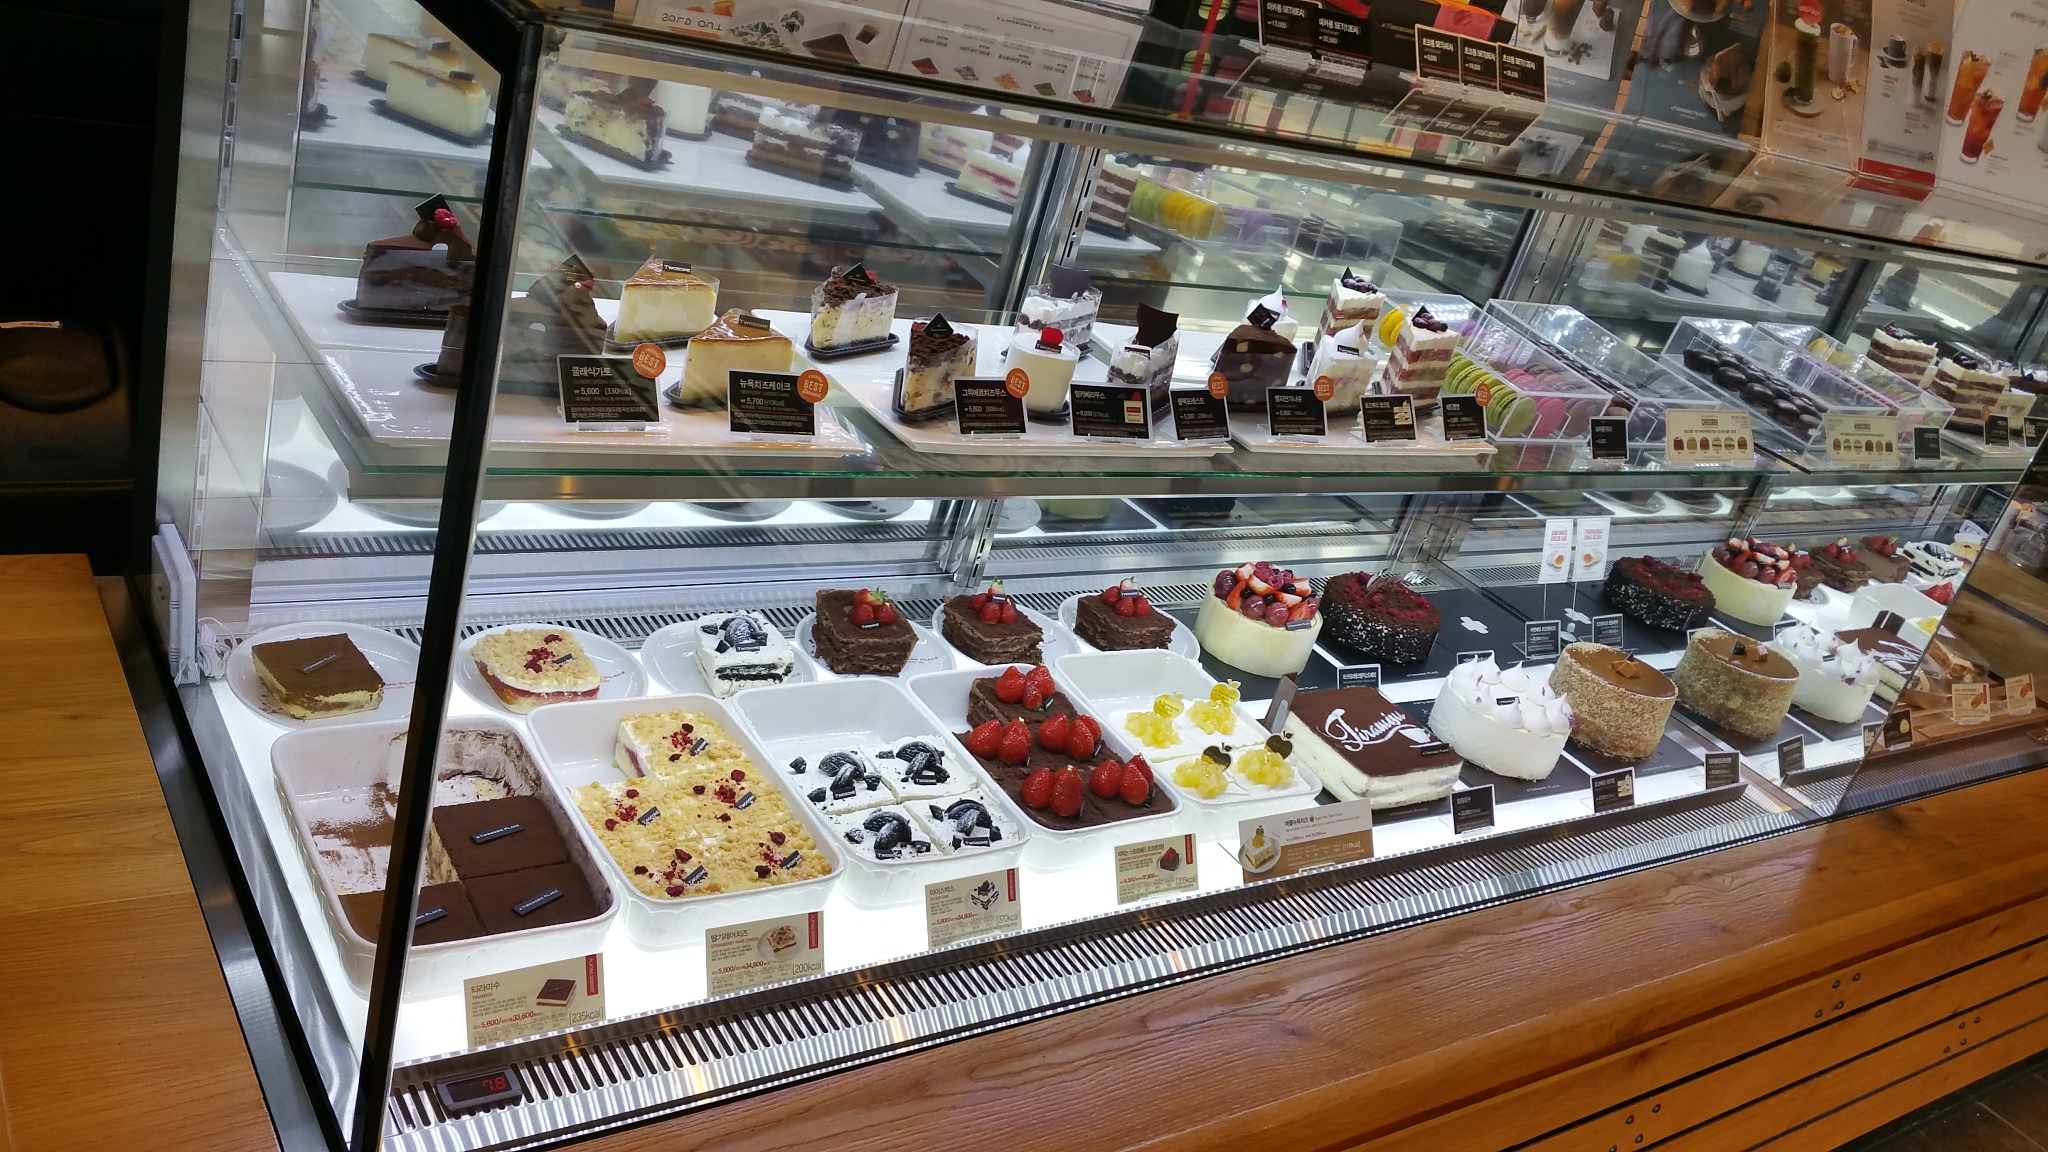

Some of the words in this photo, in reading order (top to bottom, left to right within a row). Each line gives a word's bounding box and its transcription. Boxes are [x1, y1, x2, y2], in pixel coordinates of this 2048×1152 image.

[664, 264, 691, 273] TWOSOME
[739, 318, 768, 329] TWOSOME
[1037, 343, 1060, 353] TWOSOME
[638, 351, 660, 368] BEST
[571, 366, 612, 377] 클래식가토
[739, 379, 791, 391] 뉴욕치즈케이크
[803, 379, 824, 393] BEST
[1011, 375, 1025, 390] BEST
[1211, 381, 1224, 389] BEST
[1317, 384, 1330, 392] BEST
[1325, 707, 1406, 751] Tiramisu
[835, 790, 856, 798] TWOSOME
[504, 824, 520, 832] PLACE
[543, 889, 559, 898] PLACE
[929, 886, 955, 896] 아이스박스
[425, 908, 442, 916] PLACE
[710, 929, 749, 943] 딸기레어치즈
[792, 959, 824, 976] [200kcal]
[471, 981, 501, 994] 티라미수
[471, 992, 494, 1000] TIRAMISU
[568, 1006, 604, 1026] [235kcal]
